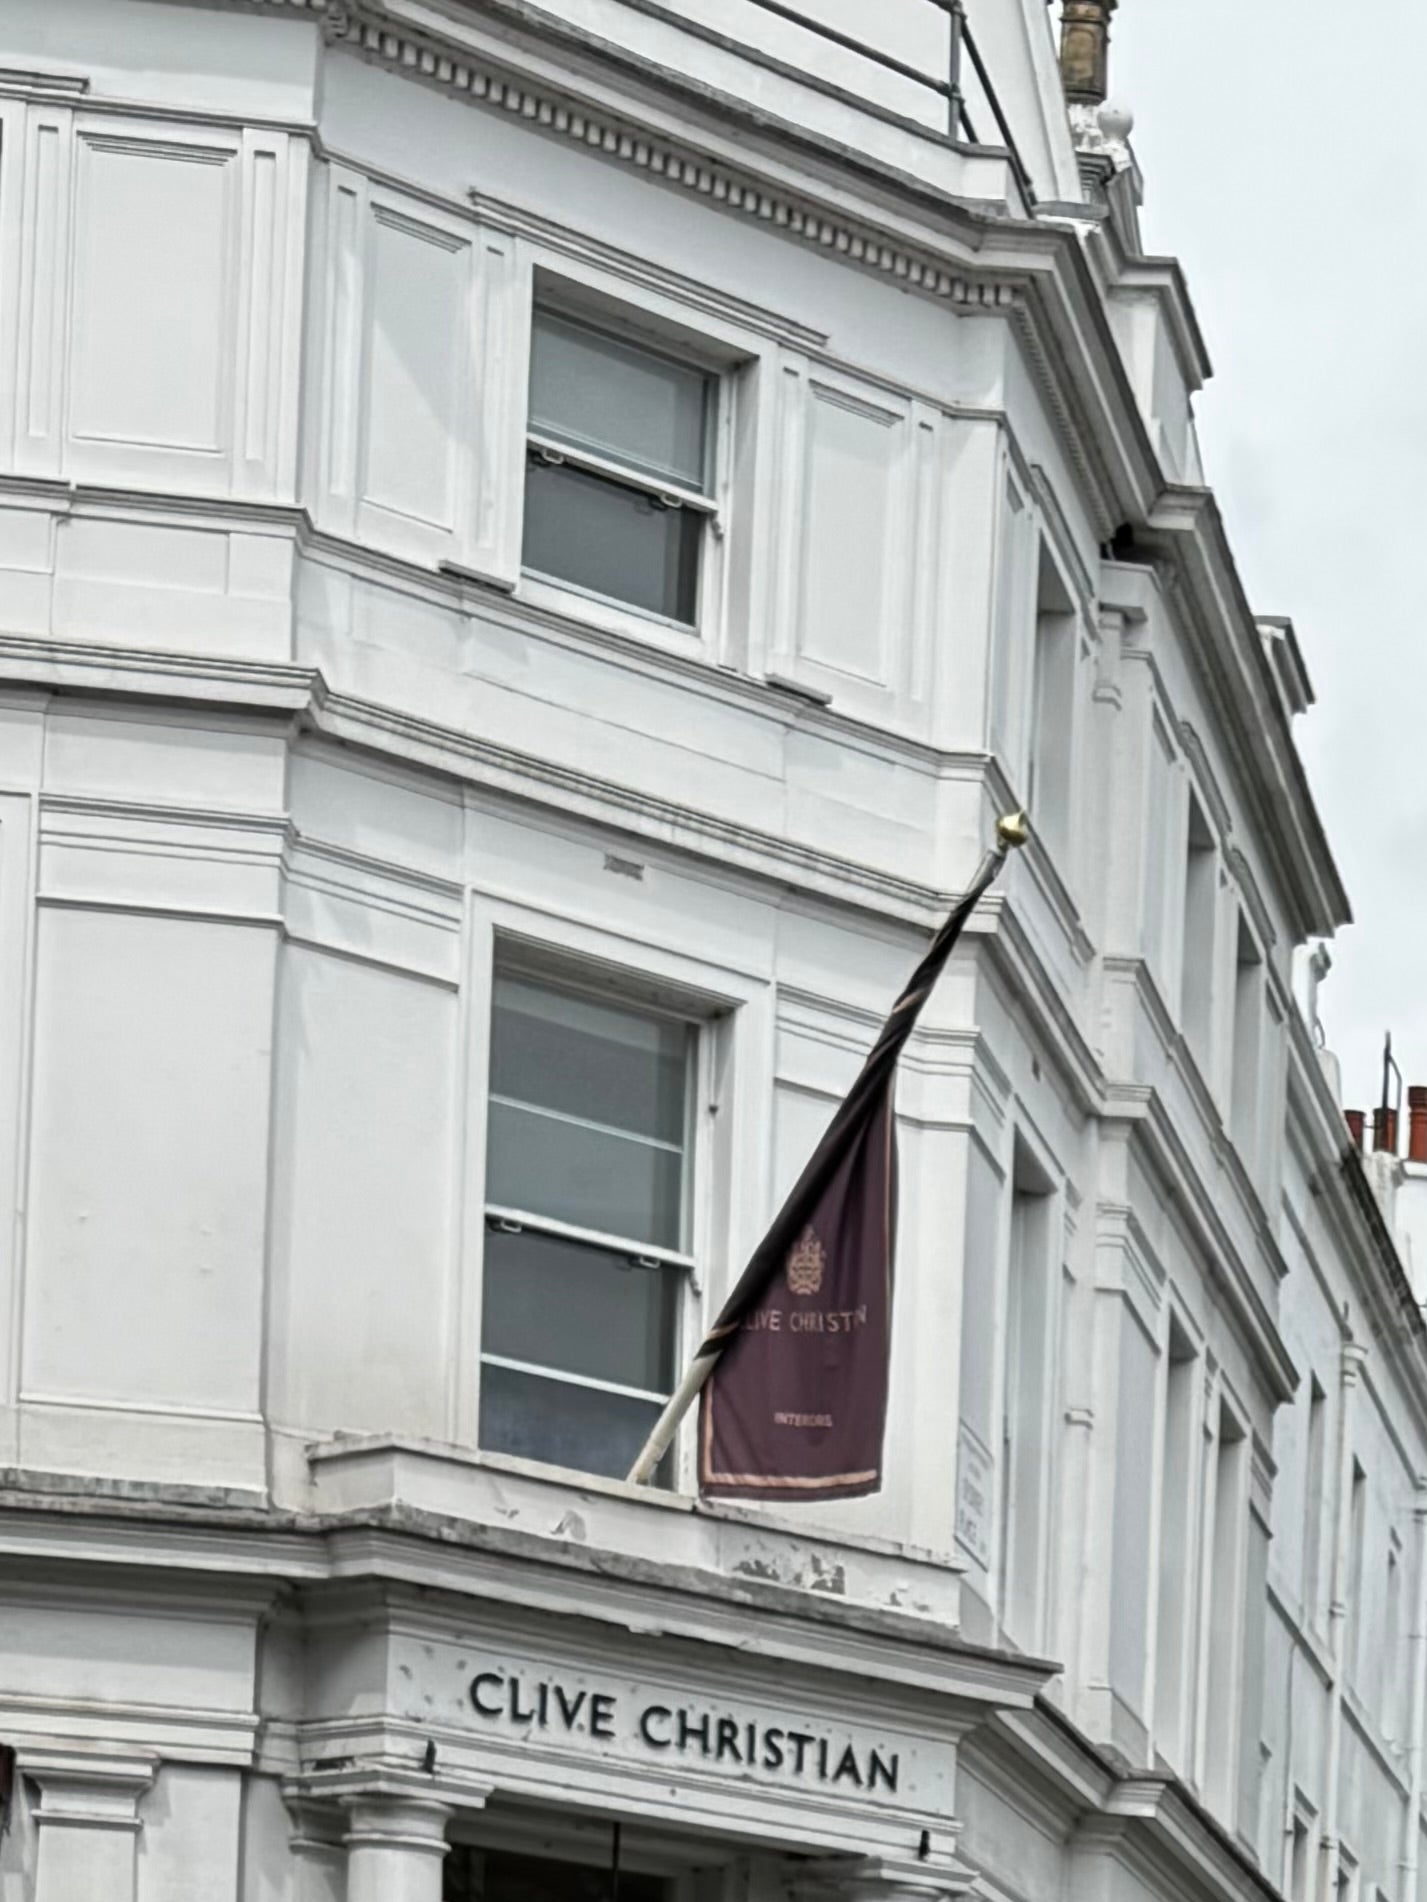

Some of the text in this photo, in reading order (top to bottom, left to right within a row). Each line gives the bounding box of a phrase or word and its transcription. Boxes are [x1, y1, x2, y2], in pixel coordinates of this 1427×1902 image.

[745, 1304, 867, 1333] LIVE CHRISTN
[468, 1671, 900, 1793] CLIVE CHRISTIAN
